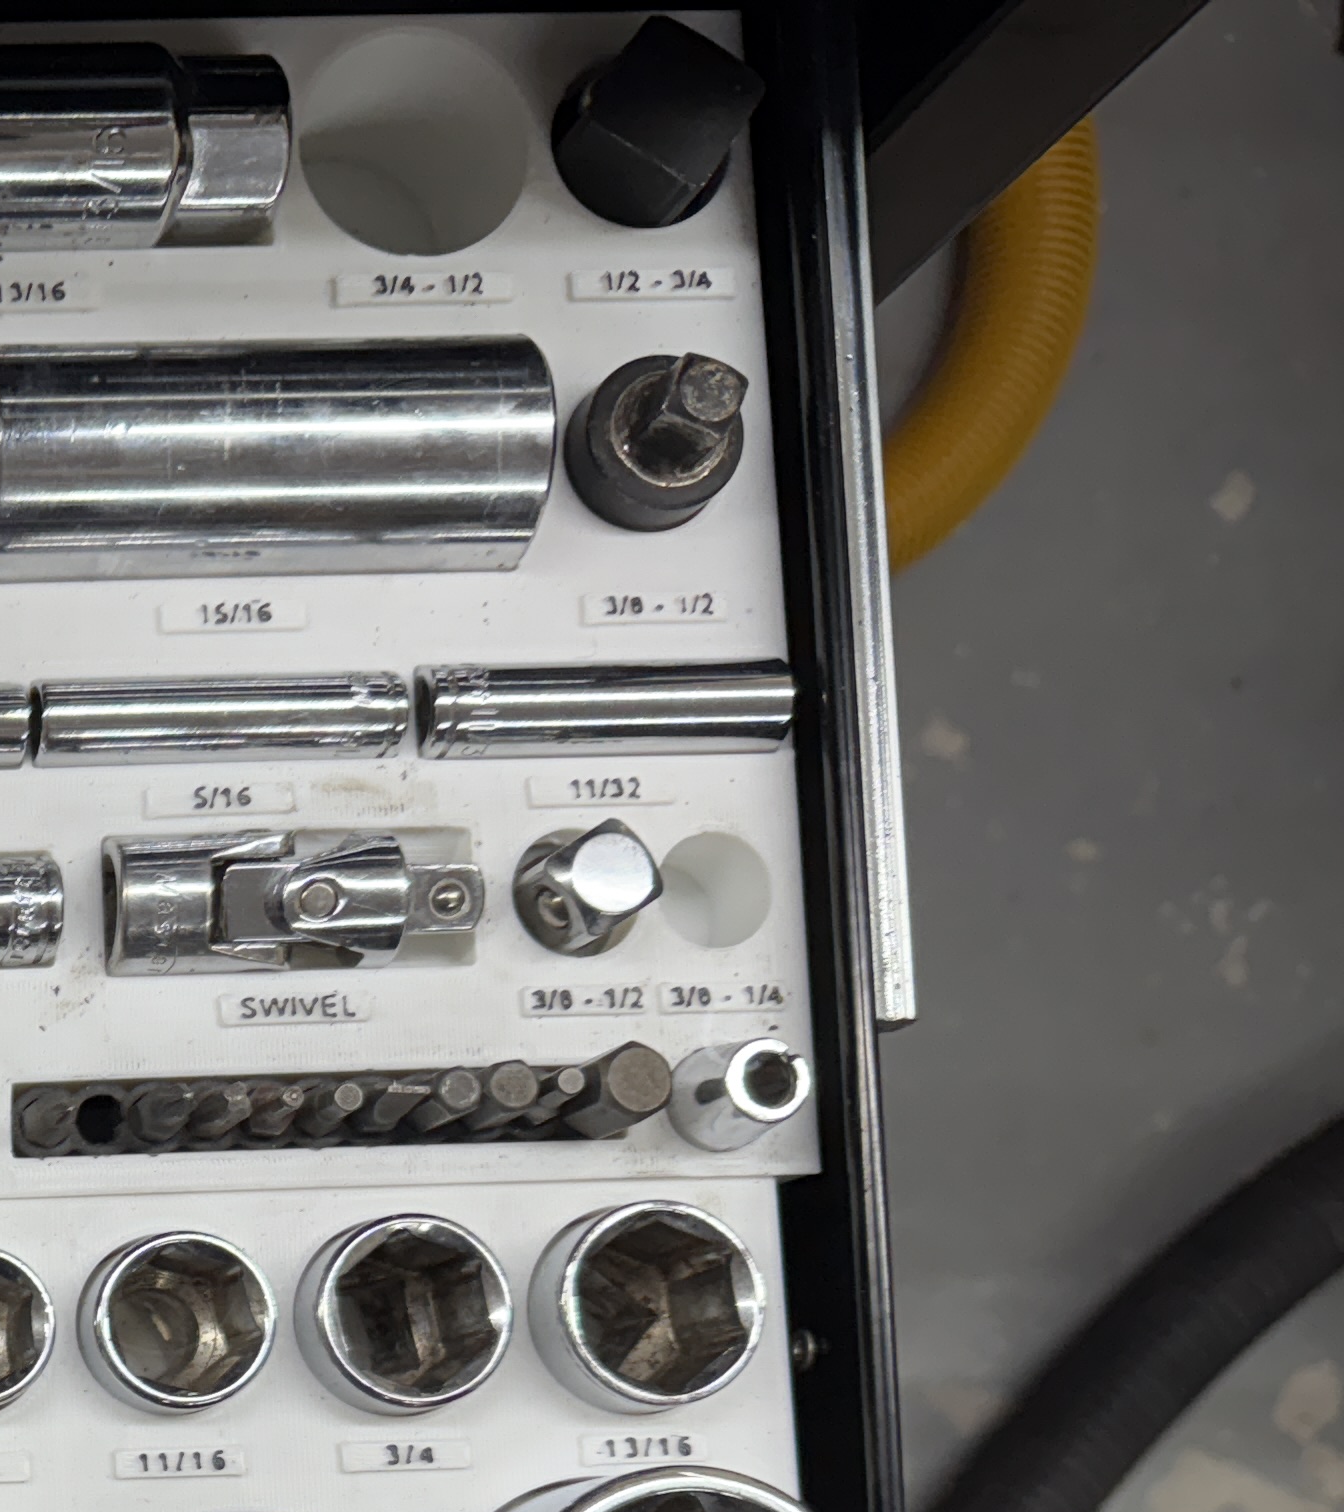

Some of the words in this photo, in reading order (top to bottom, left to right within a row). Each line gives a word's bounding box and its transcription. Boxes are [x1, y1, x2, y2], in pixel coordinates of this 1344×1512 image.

[203, 603, 272, 624] 15/16
[194, 786, 251, 809] 5/16
[571, 777, 640, 798] 11/32
[241, 994, 356, 1019] SWIVEL
[386, 1445, 434, 1465] 3/4
[606, 1437, 691, 1458] 13/16
[139, 1450, 225, 1471] 11/16
